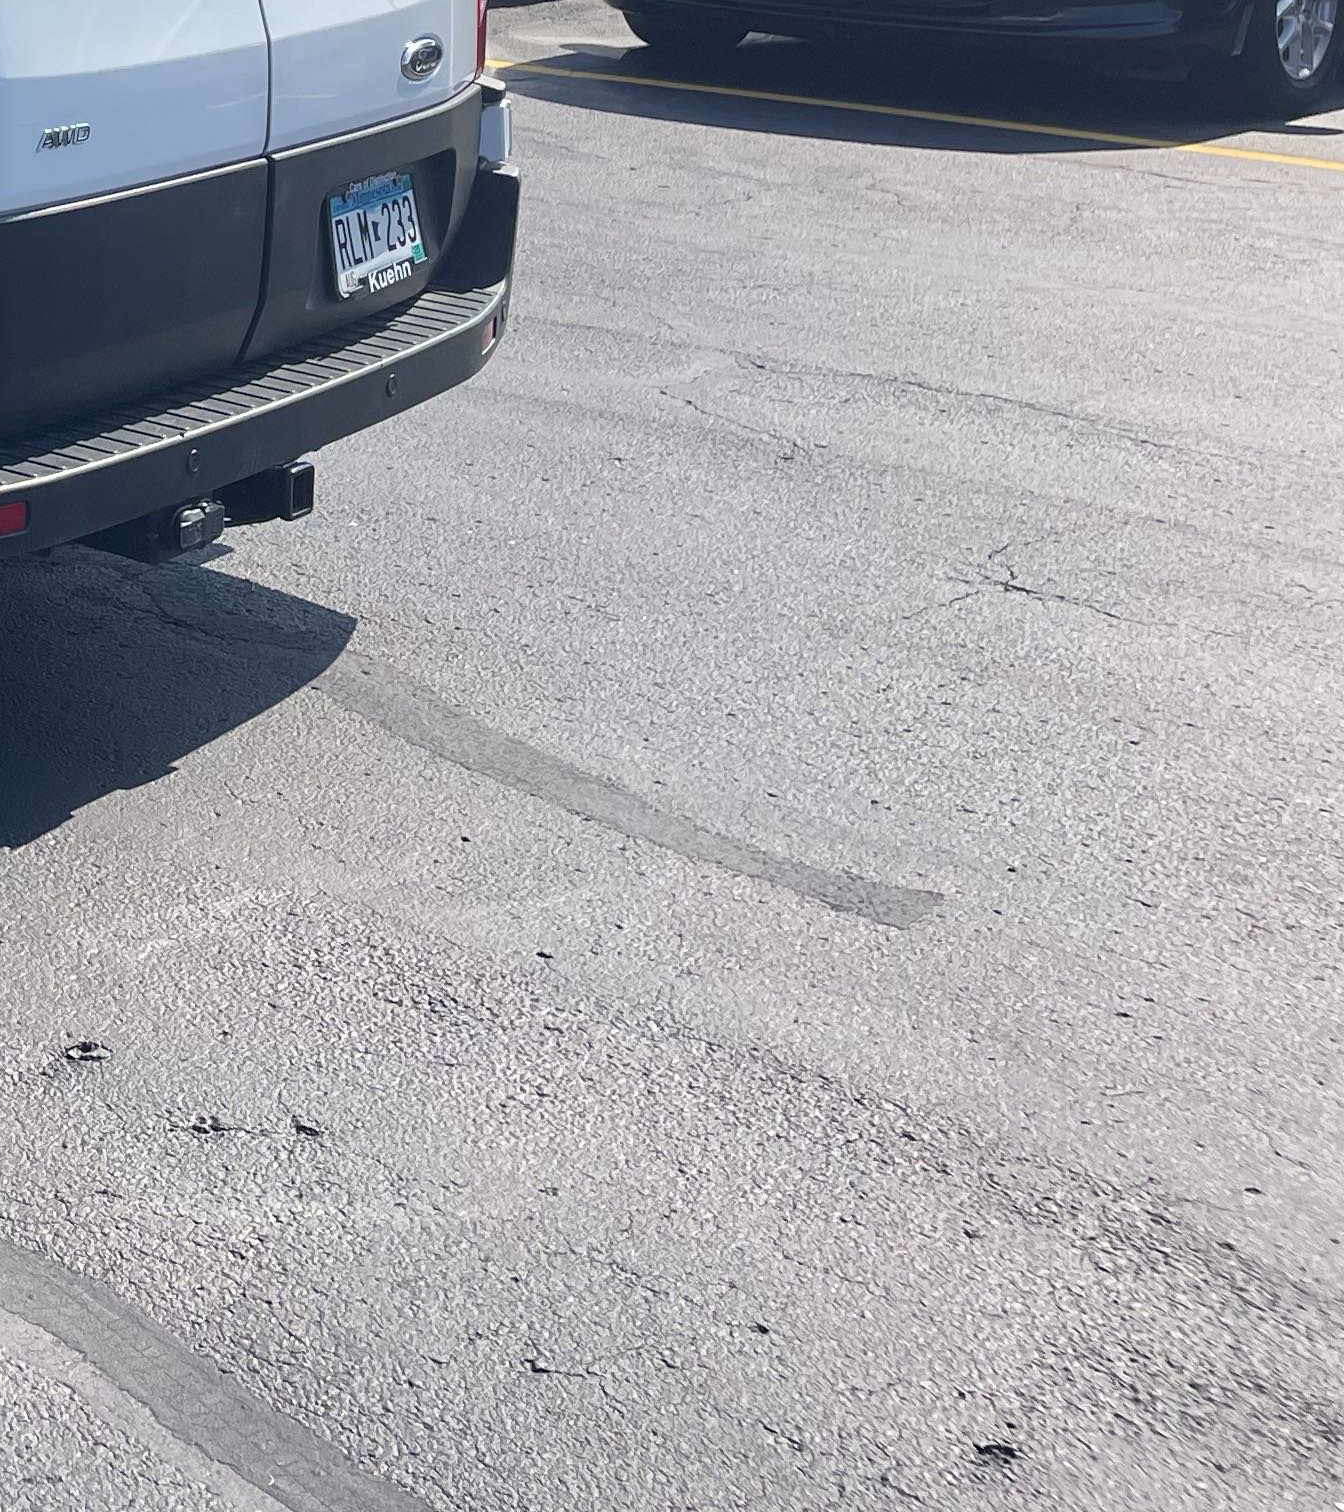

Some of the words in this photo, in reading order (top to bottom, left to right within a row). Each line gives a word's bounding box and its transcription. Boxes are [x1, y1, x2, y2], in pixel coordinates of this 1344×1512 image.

[35, 122, 91, 153] AWD
[334, 209, 375, 270] RLM
[380, 195, 417, 252] 233
[367, 260, 412, 293] Kuehn
